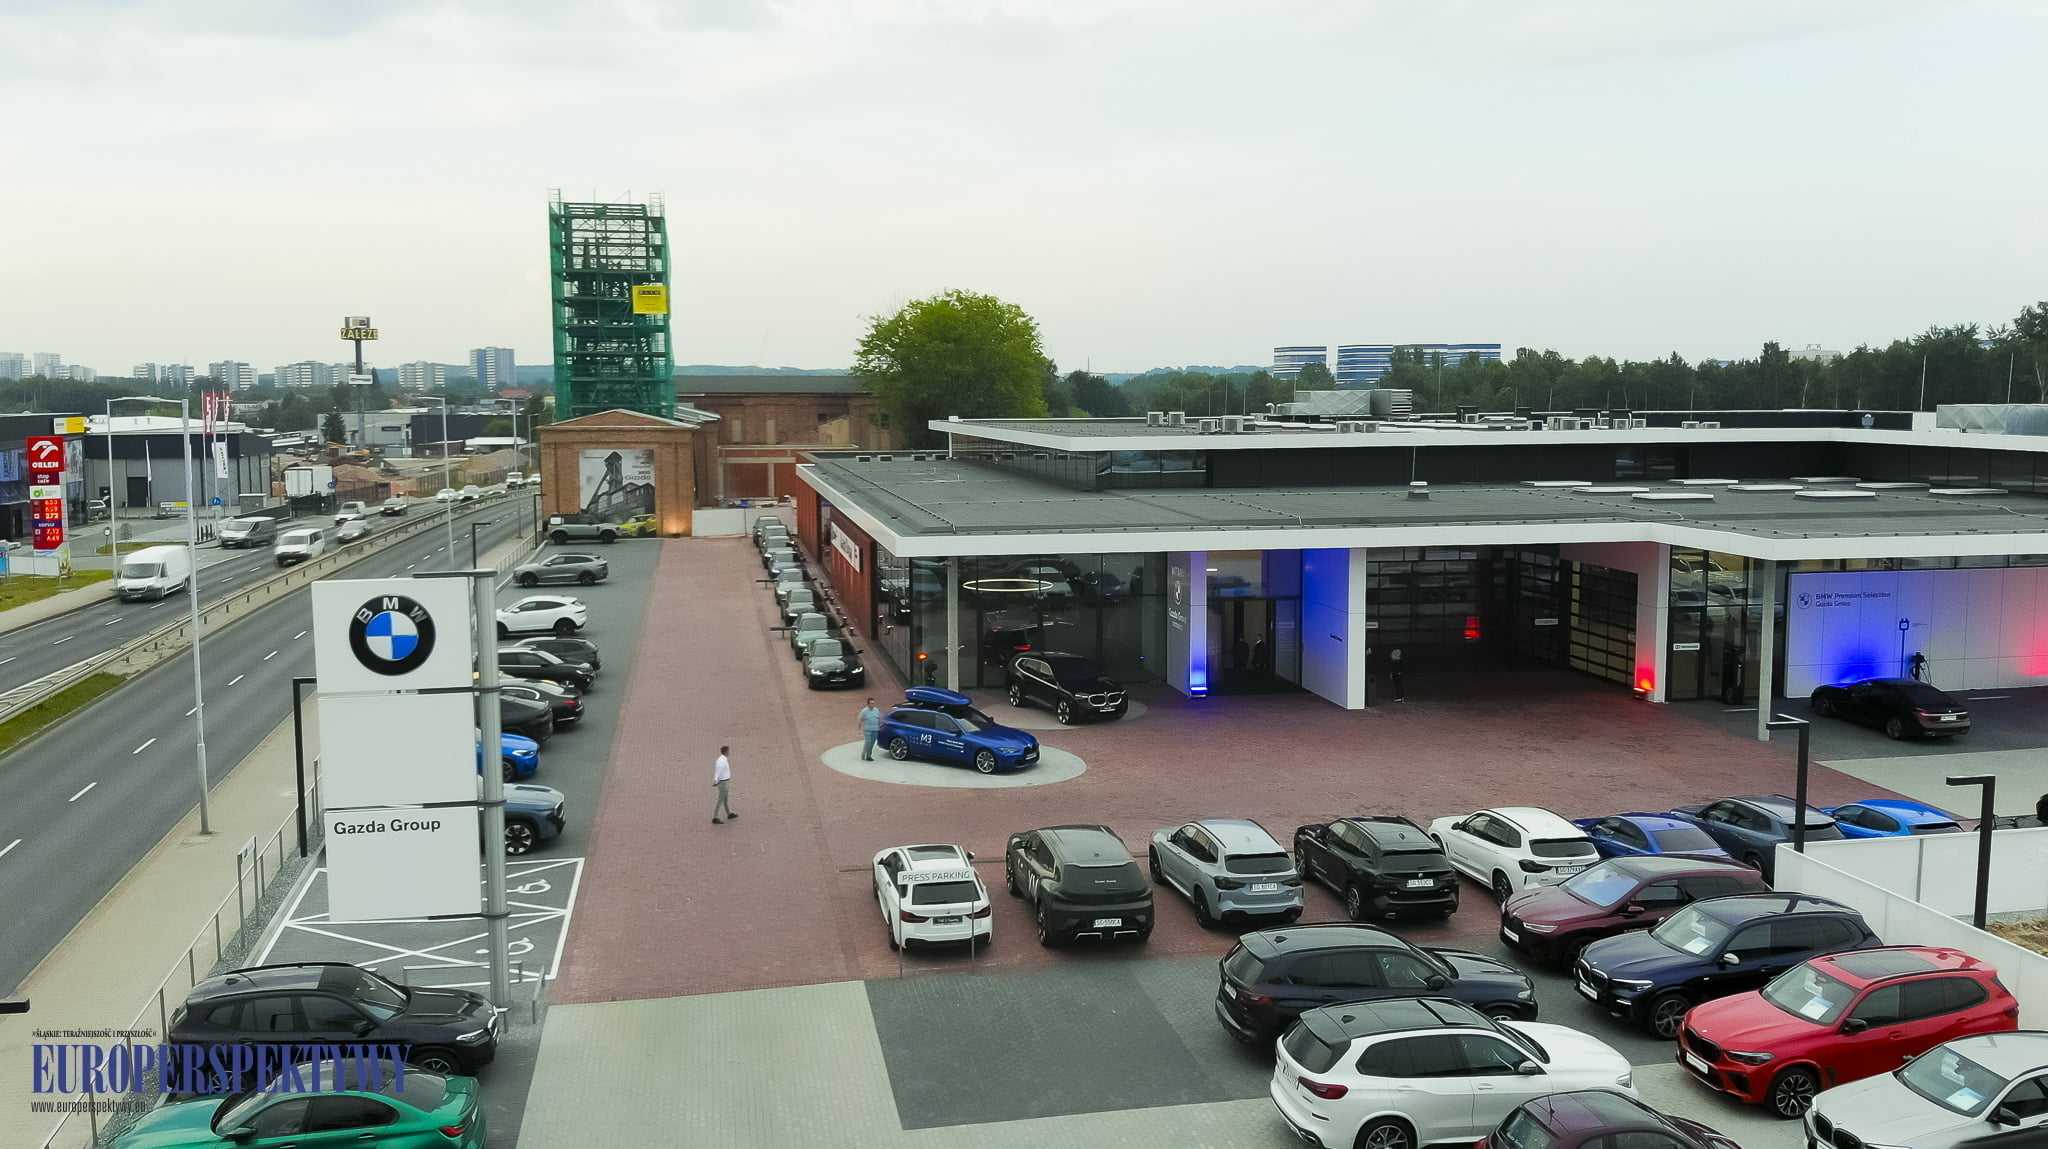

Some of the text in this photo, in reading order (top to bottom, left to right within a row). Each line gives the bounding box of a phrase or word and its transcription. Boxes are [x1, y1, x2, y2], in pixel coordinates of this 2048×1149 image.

[356, 597, 428, 624] BMW
[334, 819, 441, 834] Gazda Group
[902, 871, 970, 881] PRESS PARKING
